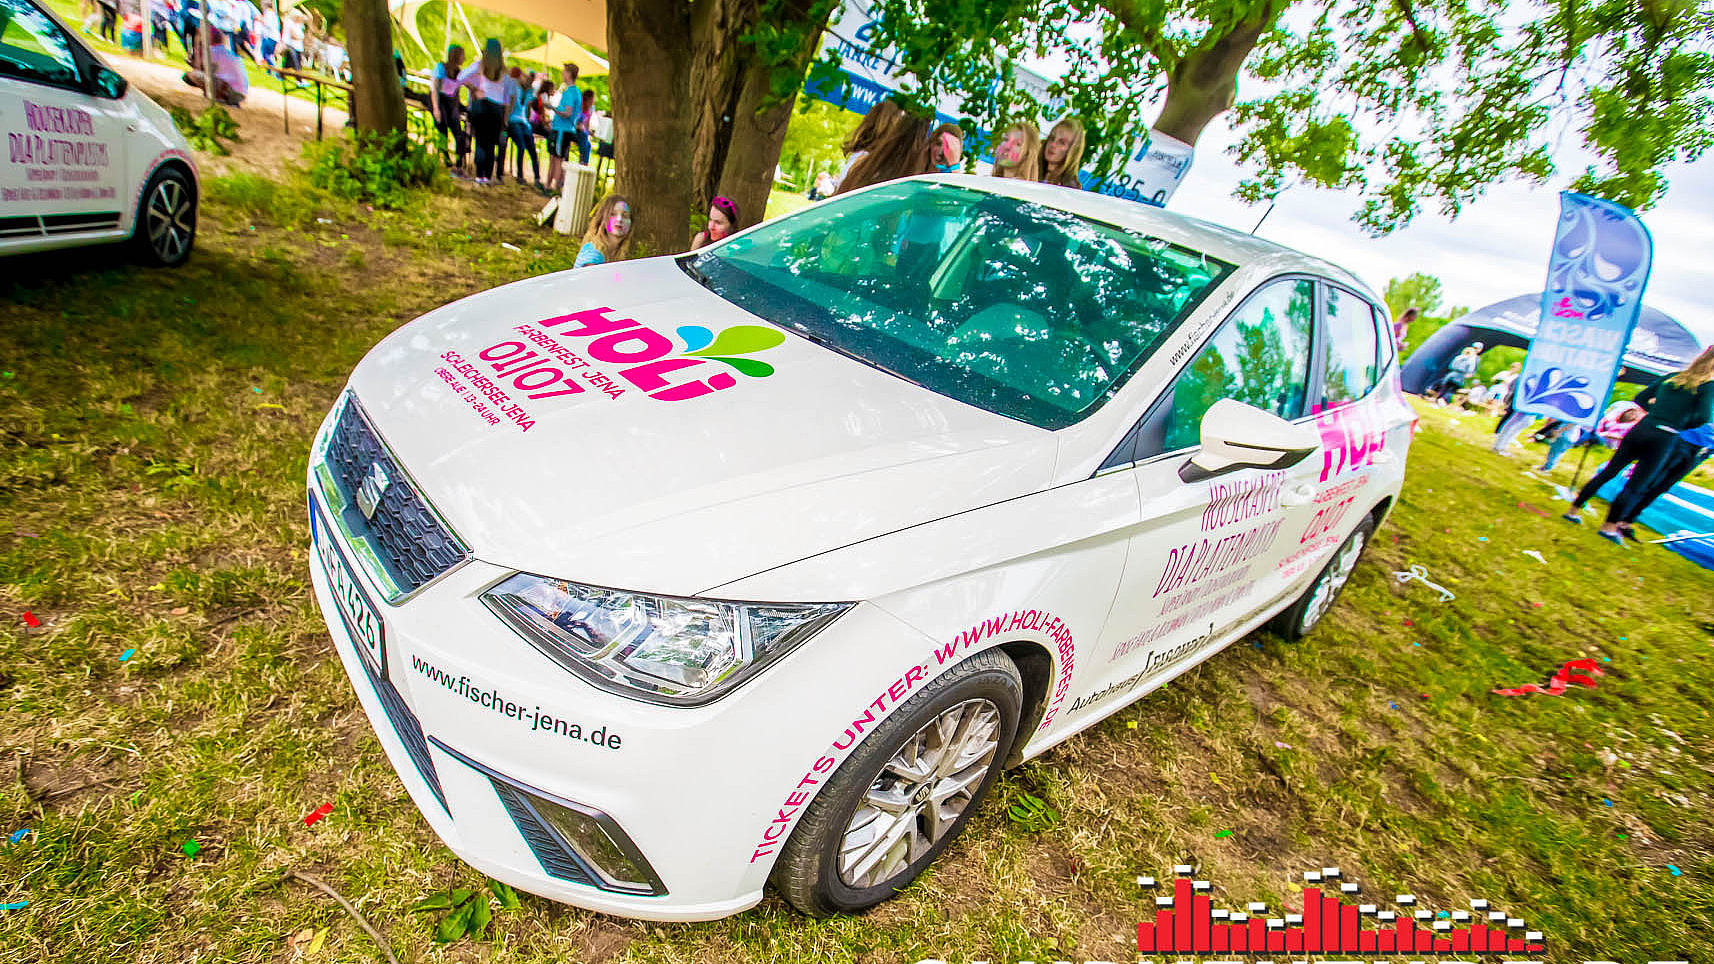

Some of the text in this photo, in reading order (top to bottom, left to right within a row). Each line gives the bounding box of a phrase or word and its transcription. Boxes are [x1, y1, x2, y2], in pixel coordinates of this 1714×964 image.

[440, 351, 536, 432] SCHLEICHERSEE JENA
[512, 324, 627, 402] FARBENFEST JENA
[411, 653, 623, 750] www.fischer-jena.de
[750, 754, 836, 863] TICKETS
[832, 664, 929, 751] UNTER:
